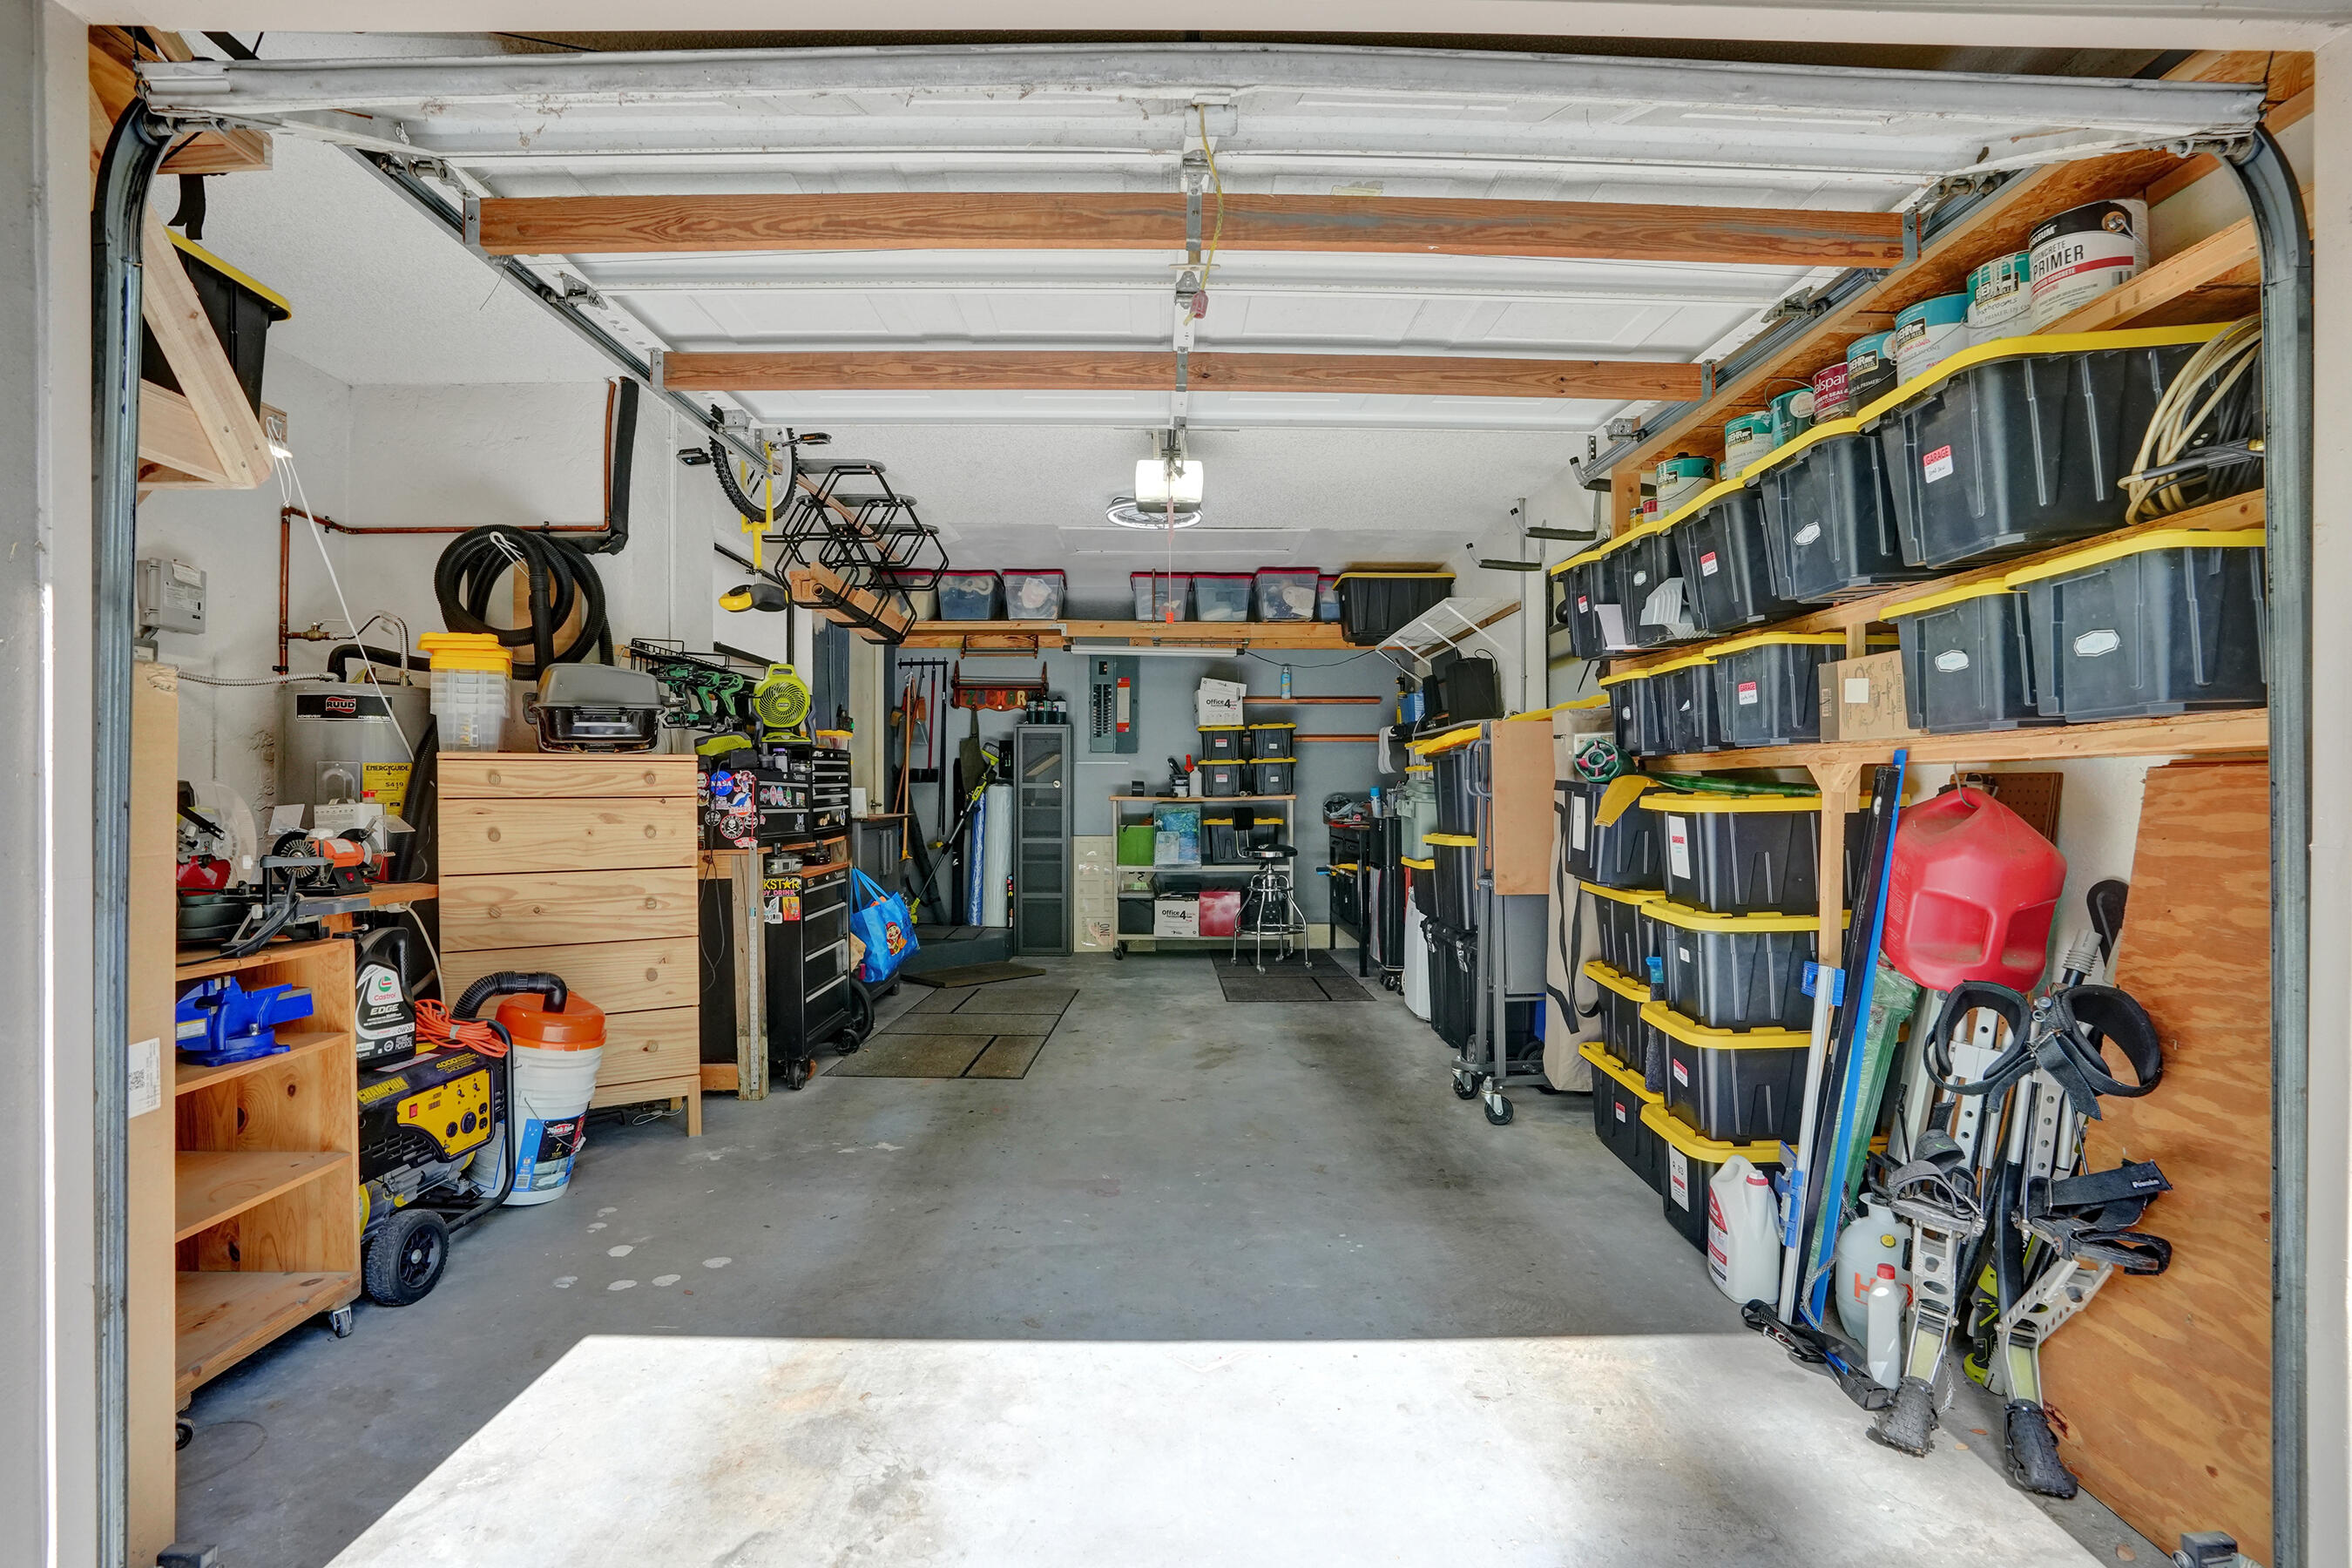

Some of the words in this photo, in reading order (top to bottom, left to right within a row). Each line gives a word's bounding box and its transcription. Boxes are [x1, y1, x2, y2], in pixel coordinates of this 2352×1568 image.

[2033, 240, 2066, 261] CONCRETE
[2033, 244, 2084, 280] PRIMER
[1814, 372, 1848, 395] alspar
[1925, 447, 1950, 465] GARAGE
[965, 689, 1033, 706] ZACHAR
[1224, 699, 1231, 708] 4
[1179, 909, 1186, 920] 4
[374, 992, 396, 1001] Castrol
[370, 1004, 399, 1016] EDGE
[436, 1058, 458, 1069] 4000
[357, 1077, 408, 1102] CHAMPION
